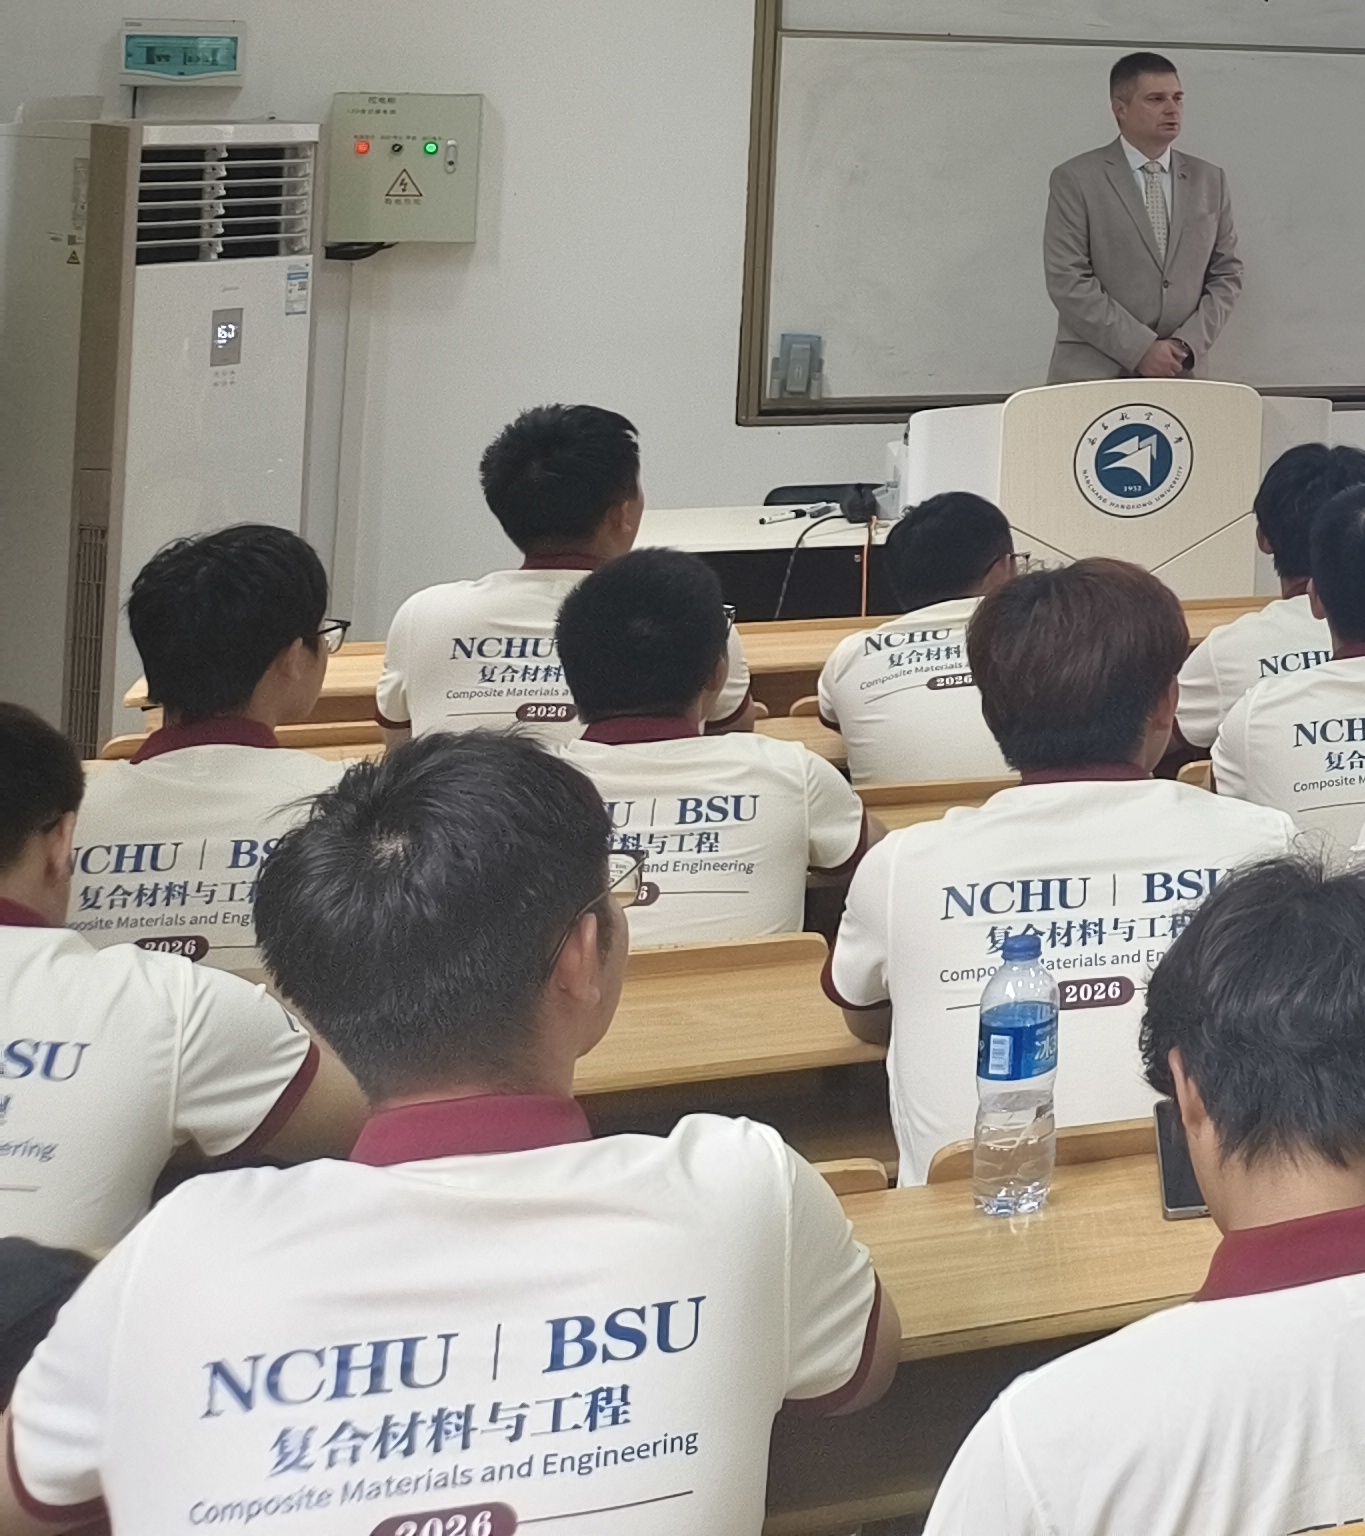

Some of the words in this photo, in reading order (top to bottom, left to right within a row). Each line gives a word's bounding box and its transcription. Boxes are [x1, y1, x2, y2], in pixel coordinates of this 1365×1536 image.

[450, 637, 556, 661] NCHU
[863, 628, 952, 657] NCHU
[887, 645, 961, 668] 复合材料
[478, 665, 564, 683] 复合材料
[860, 667, 912, 690] Composite
[915, 660, 963, 674] Materials
[446, 688, 504, 700] Composite
[506, 687, 559, 698] Materials
[526, 705, 567, 718] 2026
[1293, 776, 1355, 793] Composite
[675, 795, 760, 825] BSU
[642, 860, 669, 873] and
[672, 859, 754, 875] Engineering
[80, 880, 259, 912] 复合材料与工
[940, 877, 1091, 920] NCHU
[116, 914, 186, 929] Materials
[190, 911, 218, 925] and
[940, 965, 997, 984] Compo
[1040, 952, 1106, 972] aterials
[1111, 949, 1141, 965] and
[1065, 981, 1121, 1002] 2026
[0, 1038, 90, 1082] SU
[200, 1332, 459, 1420] NCHU
[541, 1296, 707, 1373] BSU
[266, 1384, 633, 1478] 复合材料与工程
[189, 1485, 333, 1526] Composite
[341, 1466, 474, 1503] Materials
[481, 1454, 533, 1483] and
[543, 1431, 699, 1476] Engineering
[393, 1510, 493, 1536] 2026
